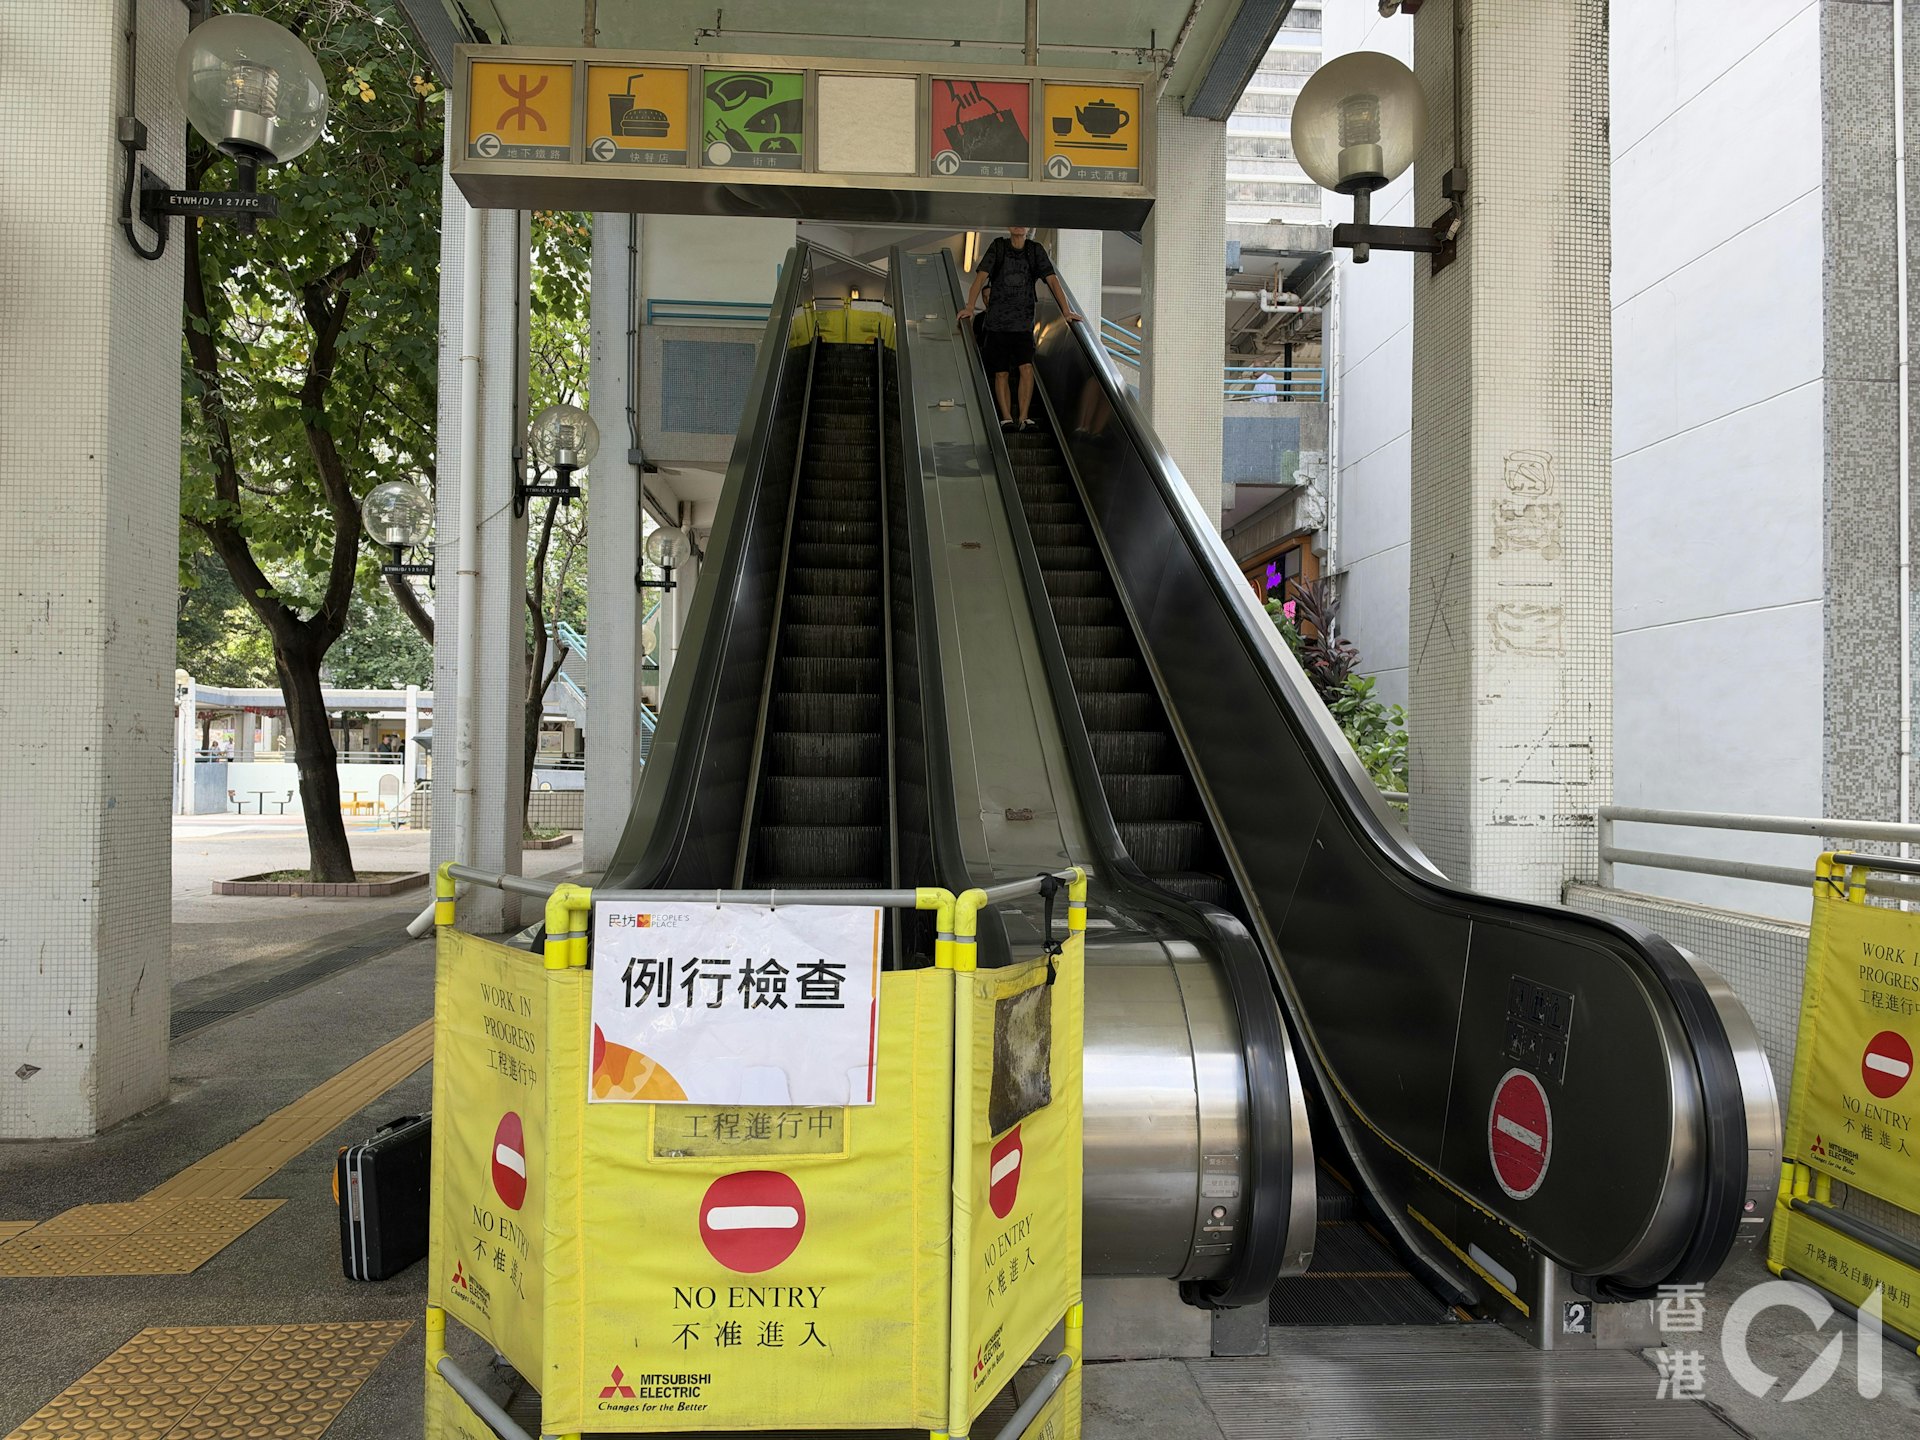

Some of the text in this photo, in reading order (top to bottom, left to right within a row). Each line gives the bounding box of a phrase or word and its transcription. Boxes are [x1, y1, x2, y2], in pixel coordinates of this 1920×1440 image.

[506, 148, 561, 160] 地下鐵路
[629, 152, 669, 163] 快餐店
[980, 166, 1004, 177] 商場
[1077, 169, 1128, 181] 中式酒樓
[608, 913, 636, 928] 民坊
[1863, 942, 1920, 968] WORK I
[620, 956, 847, 1010] 例行檢查
[1859, 964, 1920, 992] PROGRES
[480, 983, 532, 1018] WORK IN
[483, 1015, 536, 1055] PROGRESS
[486, 1048, 537, 1090] 工程進行中
[681, 1109, 834, 1140] 工程進行中
[1842, 1094, 1912, 1132] NO ENTRY
[1842, 1115, 1911, 1158] 不准進入
[1828, 1149, 1854, 1166] ELECTRIC
[472, 1203, 530, 1262] NO ENTRY
[984, 1212, 1034, 1273] NO ENTRY
[472, 1236, 525, 1300] 不准進入
[986, 1246, 1036, 1308] 不准進入
[672, 1285, 827, 1310] NO ENTRY
[1567, 1303, 1585, 1334] 2
[671, 1320, 828, 1350] 不准進入
[640, 1373, 711, 1385] MITSUBISHI
[640, 1386, 701, 1399] ELECTRIC
[598, 1401, 708, 1413] Changes for the Better
